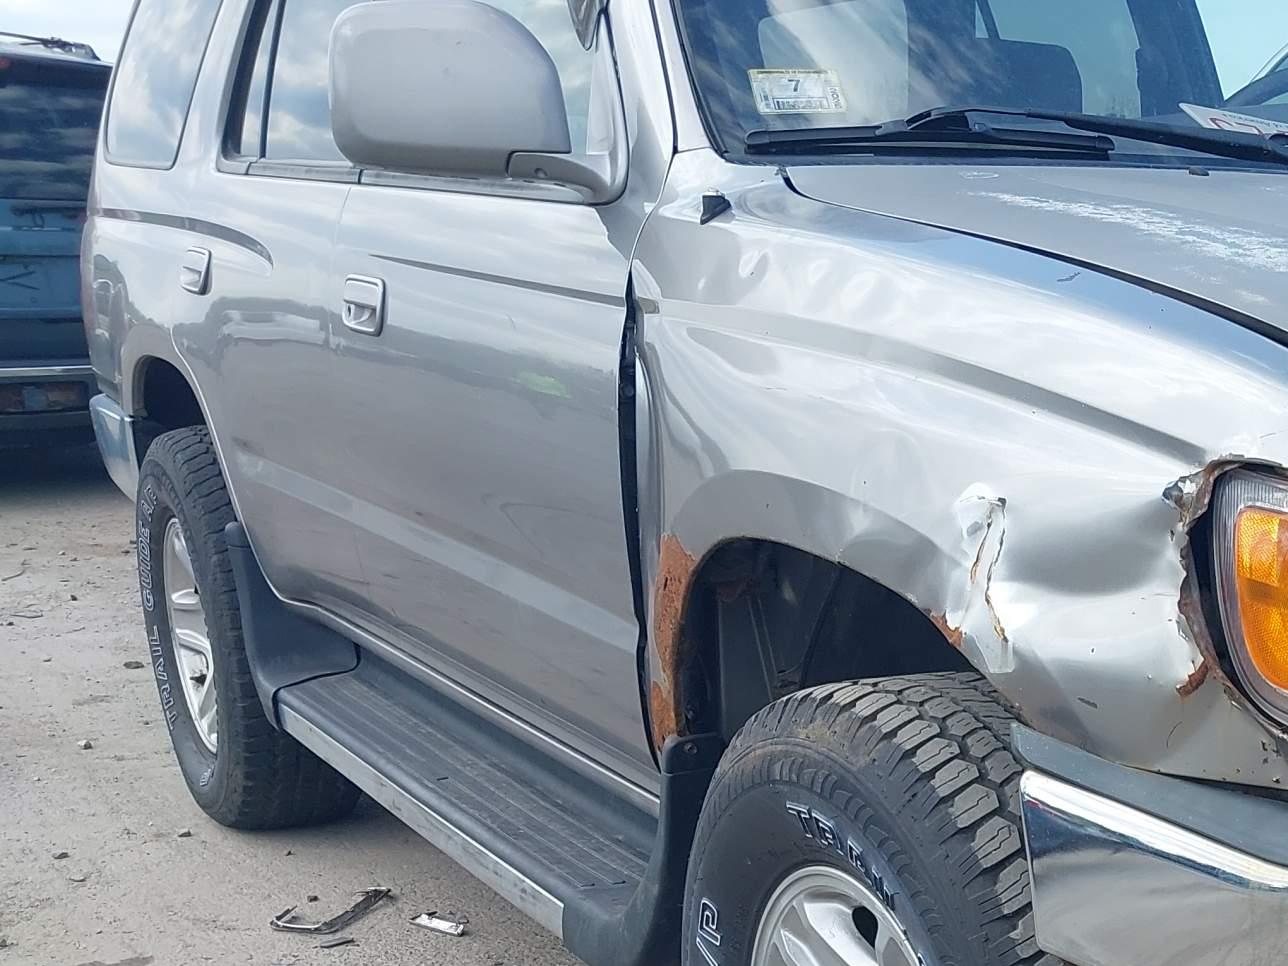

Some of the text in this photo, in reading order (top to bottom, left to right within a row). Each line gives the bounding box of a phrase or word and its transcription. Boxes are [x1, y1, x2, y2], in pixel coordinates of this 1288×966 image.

[787, 79, 801, 92] 7
[138, 519, 155, 612] GUIDE
[151, 624, 176, 731] TRAIL
